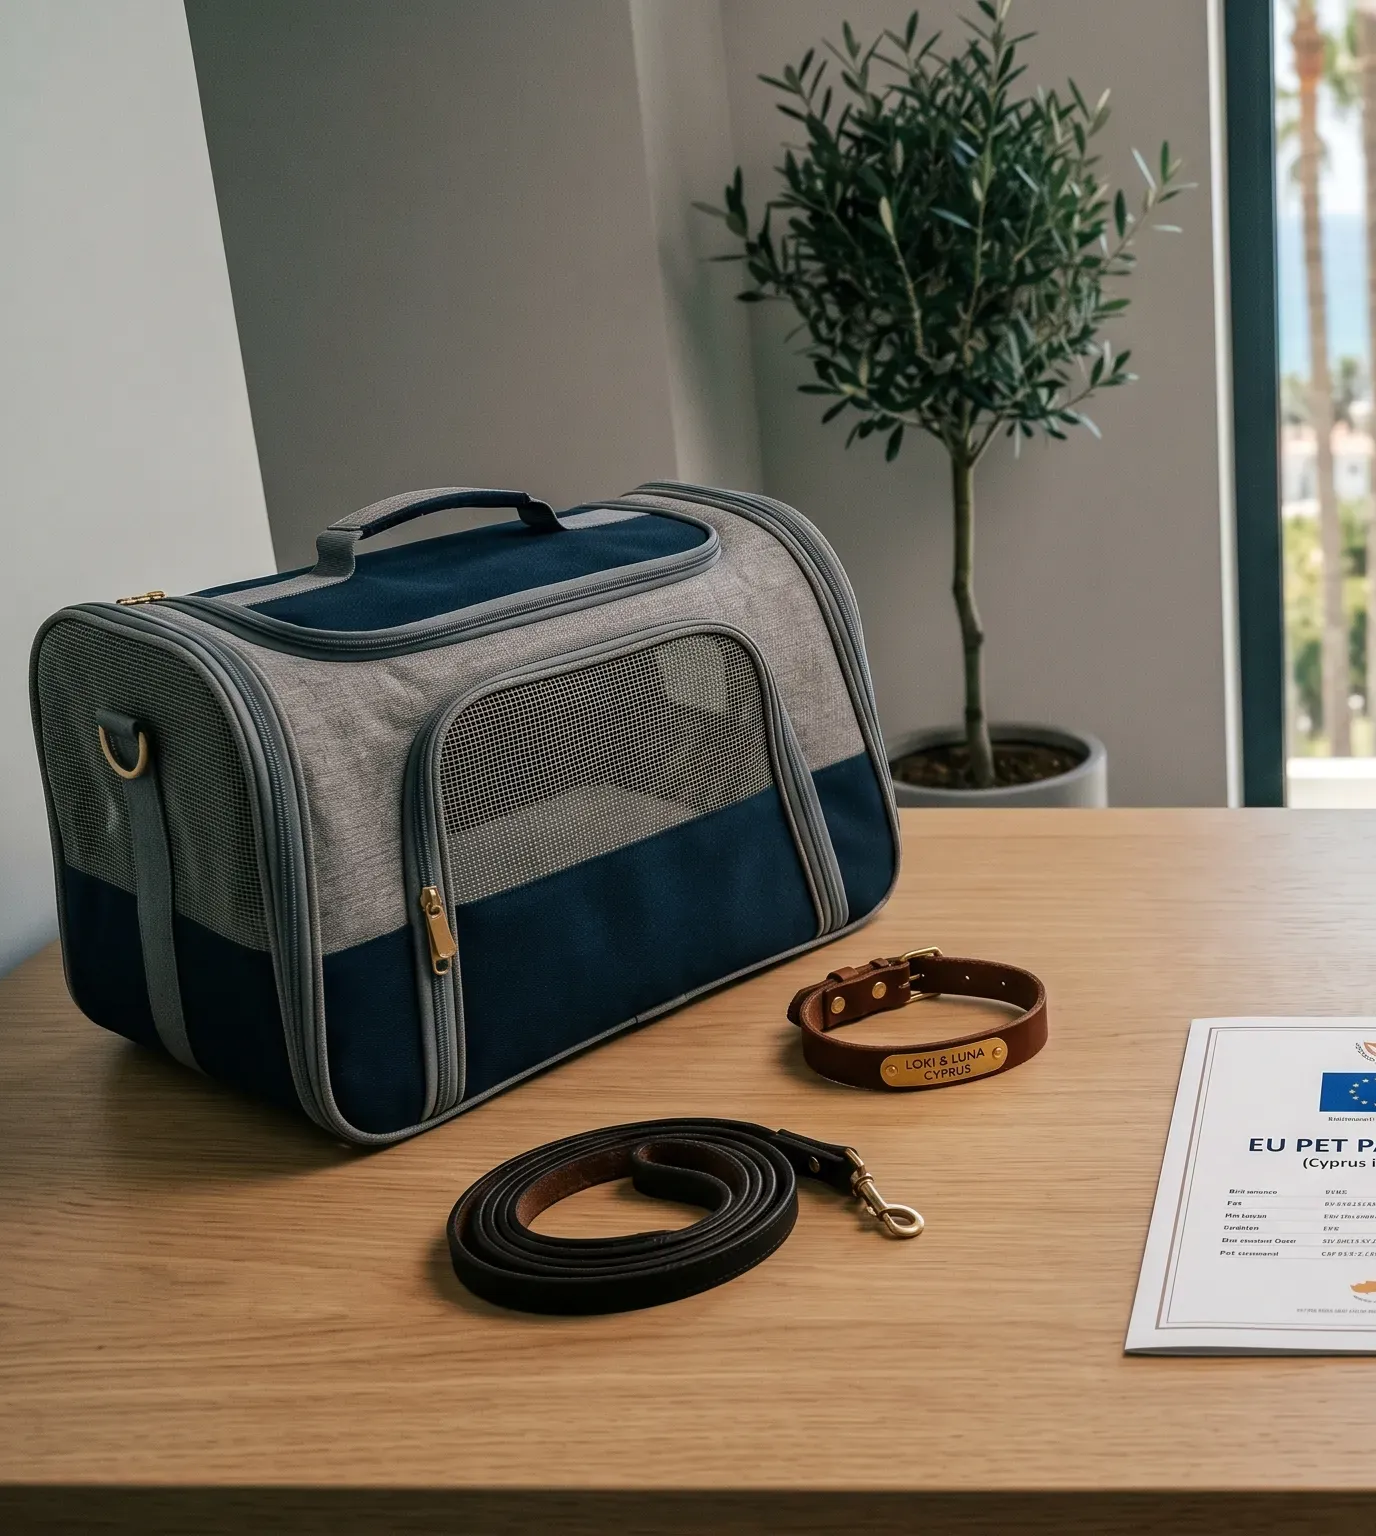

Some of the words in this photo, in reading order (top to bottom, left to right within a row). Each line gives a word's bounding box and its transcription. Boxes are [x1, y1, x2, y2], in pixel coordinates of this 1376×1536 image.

[905, 1057, 936, 1070] LOKI
[938, 1055, 949, 1066] &
[951, 1047, 985, 1064] LUNA
[923, 1064, 972, 1081] CYPRUS
[1248, 1138, 1286, 1153] EU
[1296, 1138, 1349, 1153] PET
[1302, 1157, 1367, 1171] (Cyprus
